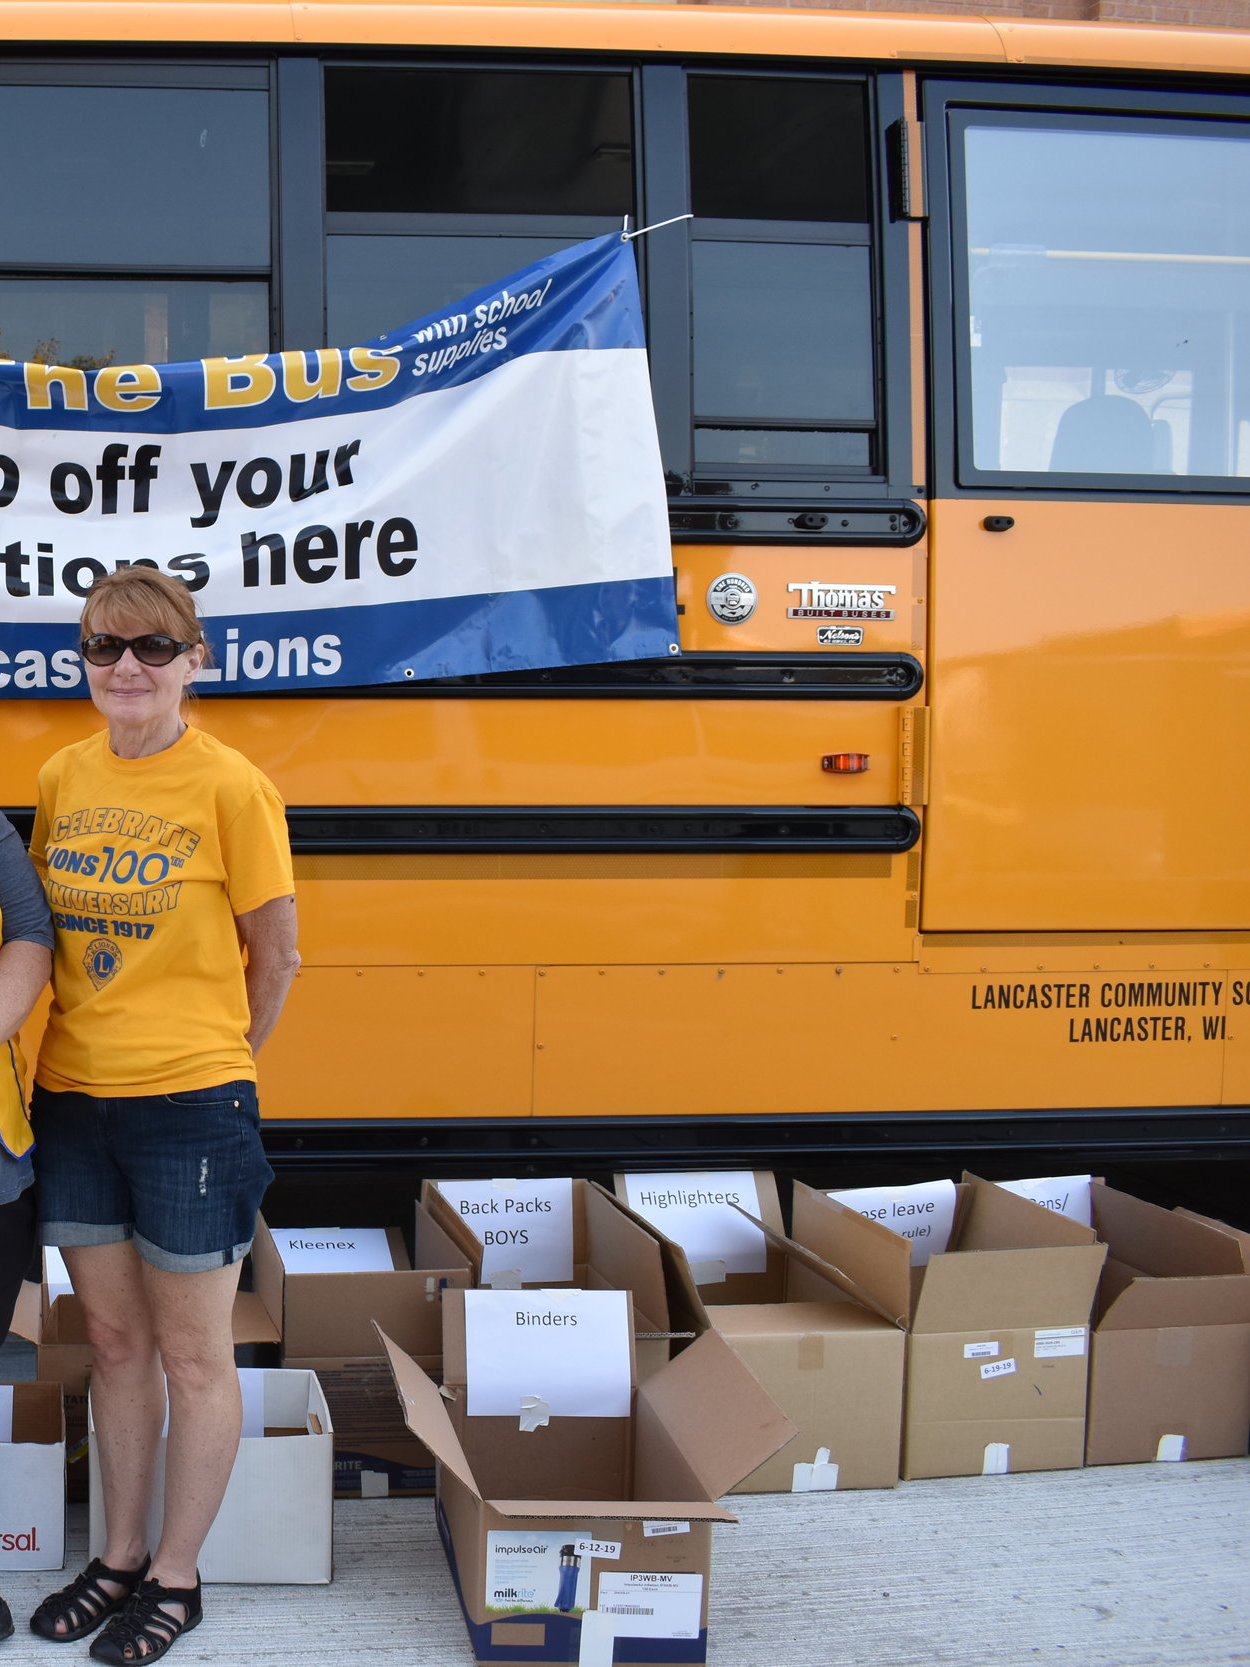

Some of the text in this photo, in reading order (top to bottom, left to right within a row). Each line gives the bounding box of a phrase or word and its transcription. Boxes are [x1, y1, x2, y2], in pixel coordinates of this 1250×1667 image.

[411, 278, 552, 343] with school
[411, 326, 508, 376] supplies
[200, 345, 403, 411] Bus
[50, 443, 161, 515] off
[189, 439, 361, 528] your
[240, 517, 418, 588] here
[787, 580, 897, 609] Thomas
[797, 608, 887, 618] BUILT BUSES
[52, 808, 202, 858] CELEBRATE
[46, 846, 100, 877] IONS
[48, 880, 183, 916] NIVERSARY
[54, 913, 155, 940] SINCE 1917
[971, 983, 1090, 1010] LANCASTER
[1100, 981, 1223, 1008] COMMUNITY
[1069, 1016, 1192, 1042] LANCASTER,
[460, 1197, 552, 1215] Back Packs
[640, 1189, 740, 1209] Highlighters
[892, 1201, 935, 1217] leave
[1029, 1193, 1069, 1211] ens/
[289, 1239, 356, 1250] Kleenex
[484, 1229, 529, 1245] BOYS
[516, 1311, 578, 1326] Binders
[984, 1361, 1012, 1375] 6-19-19
[579, 1542, 616, 1554] 6-12-19
[630, 1574, 673, 1582] IP3WB-MV
